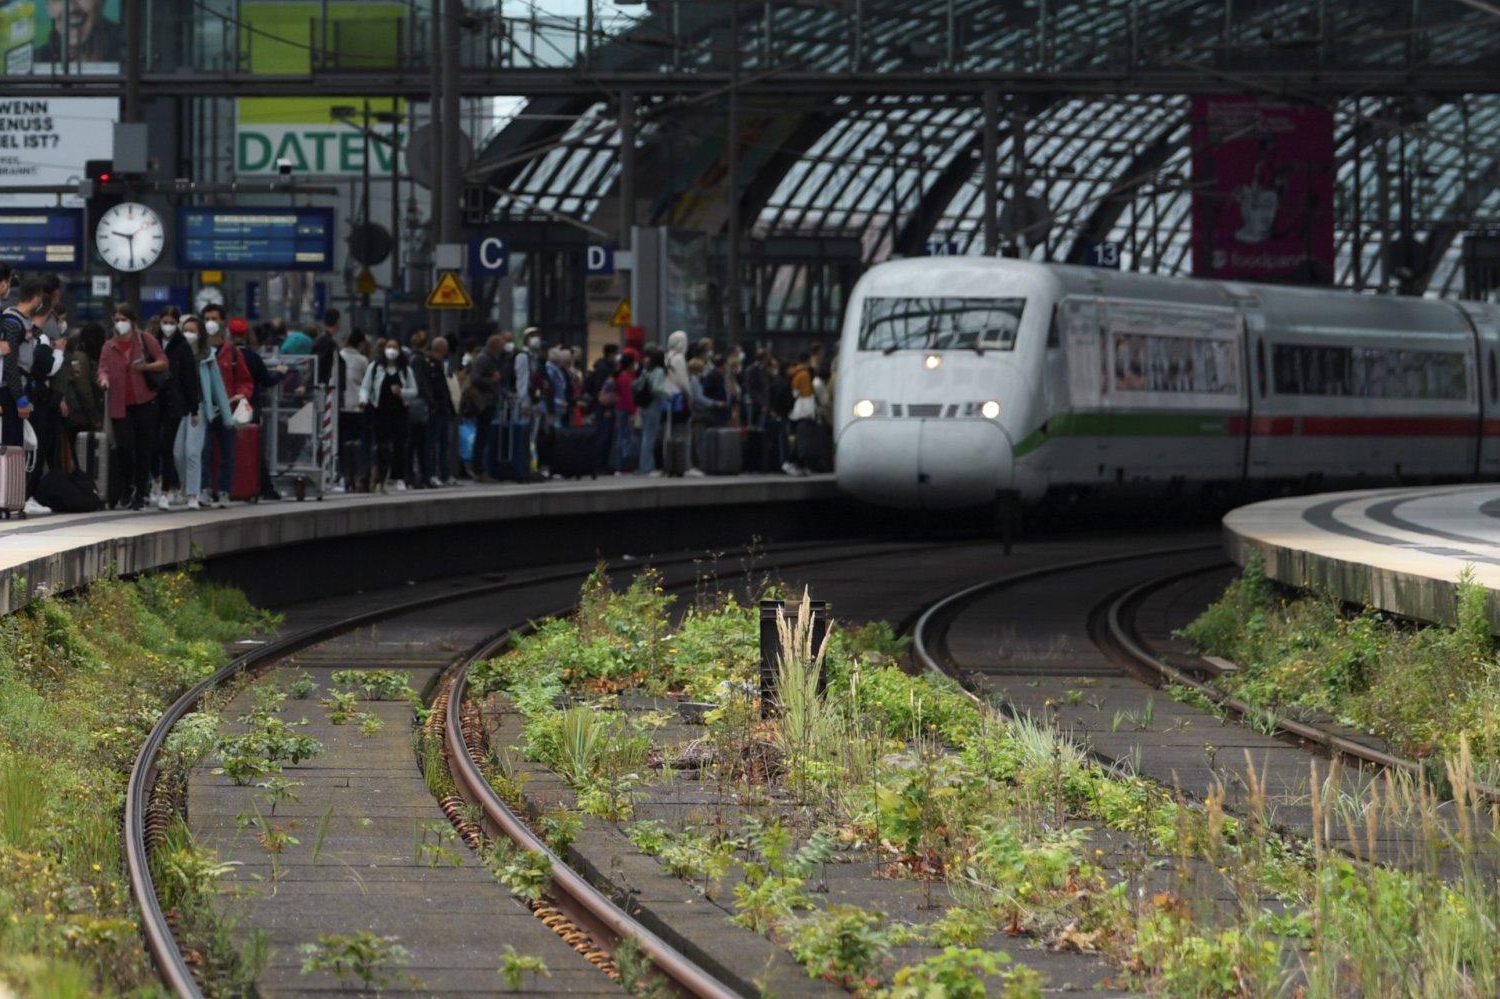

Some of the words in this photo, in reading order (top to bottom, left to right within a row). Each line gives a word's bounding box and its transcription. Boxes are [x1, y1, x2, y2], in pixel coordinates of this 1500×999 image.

[23, 134, 60, 148] IST?
[238, 131, 408, 171] DATEV
[479, 237, 503, 270] C
[587, 246, 605, 270] D
[1094, 244, 1118, 266] 13
